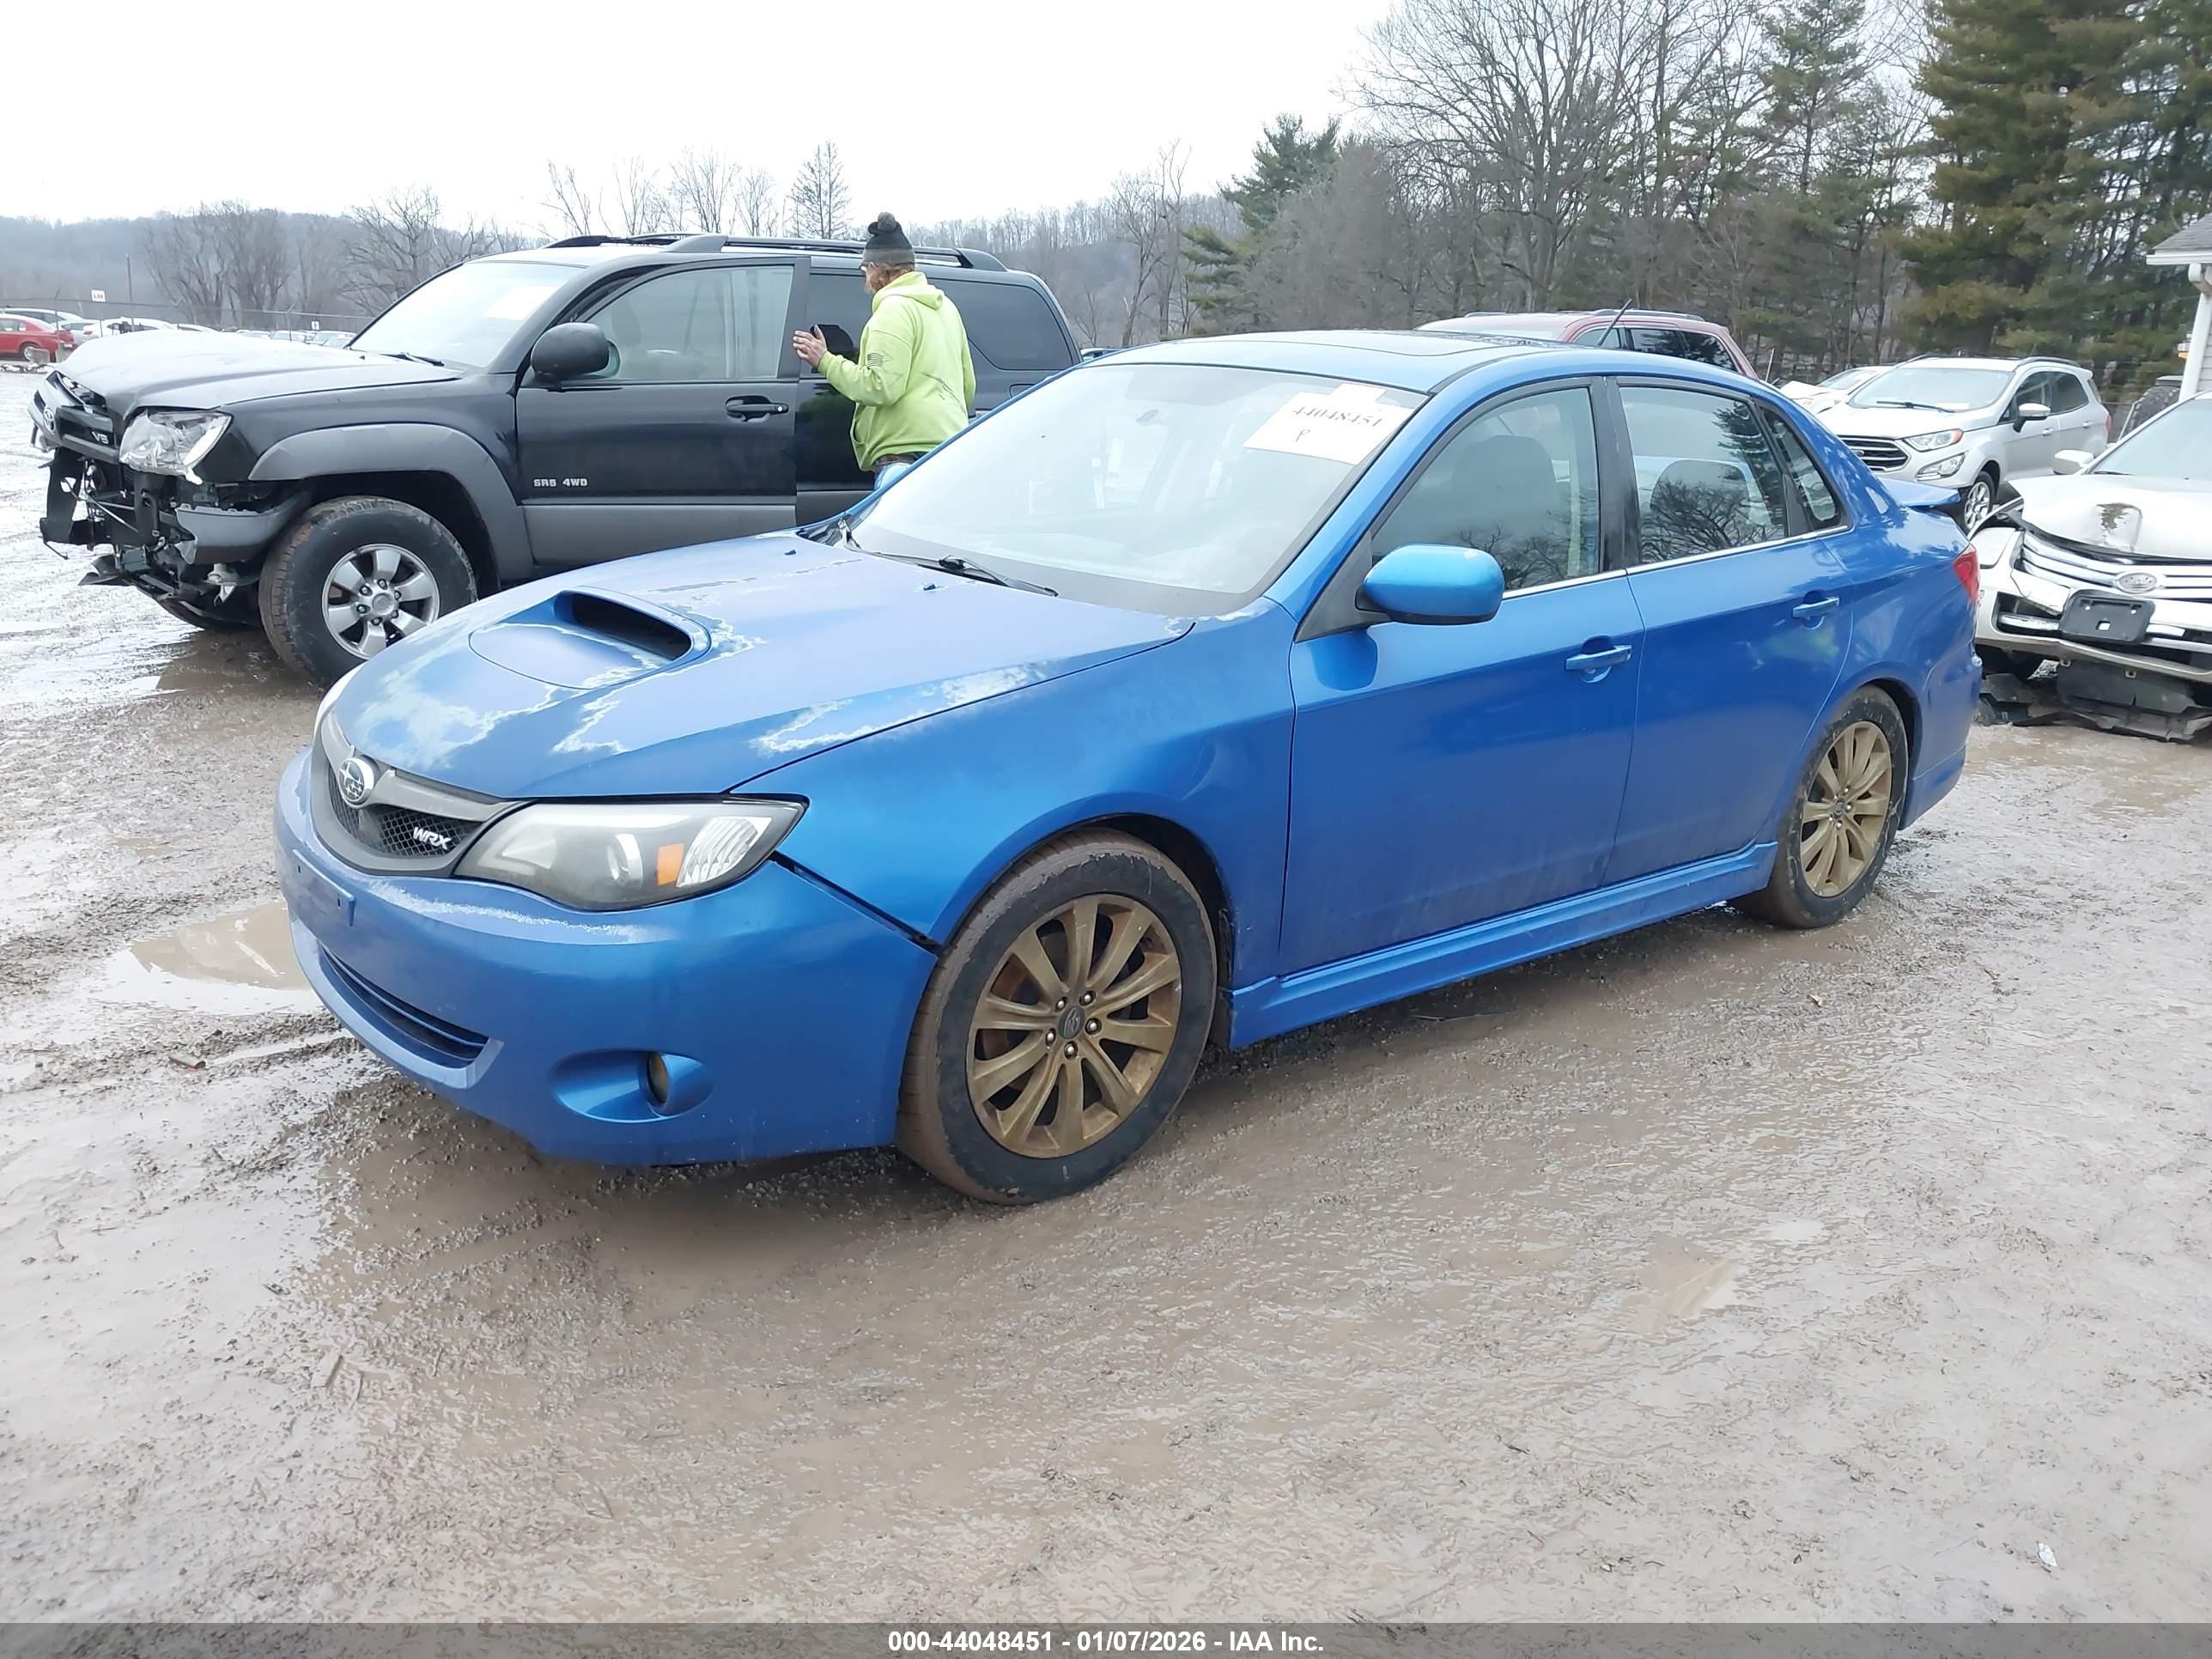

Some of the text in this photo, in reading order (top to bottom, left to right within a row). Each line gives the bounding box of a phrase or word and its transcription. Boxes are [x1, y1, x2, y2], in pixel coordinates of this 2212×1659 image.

[1291, 405, 1383, 427] 44048451
[533, 477, 588, 488] SR5 4WD
[412, 826, 452, 851] WRX
